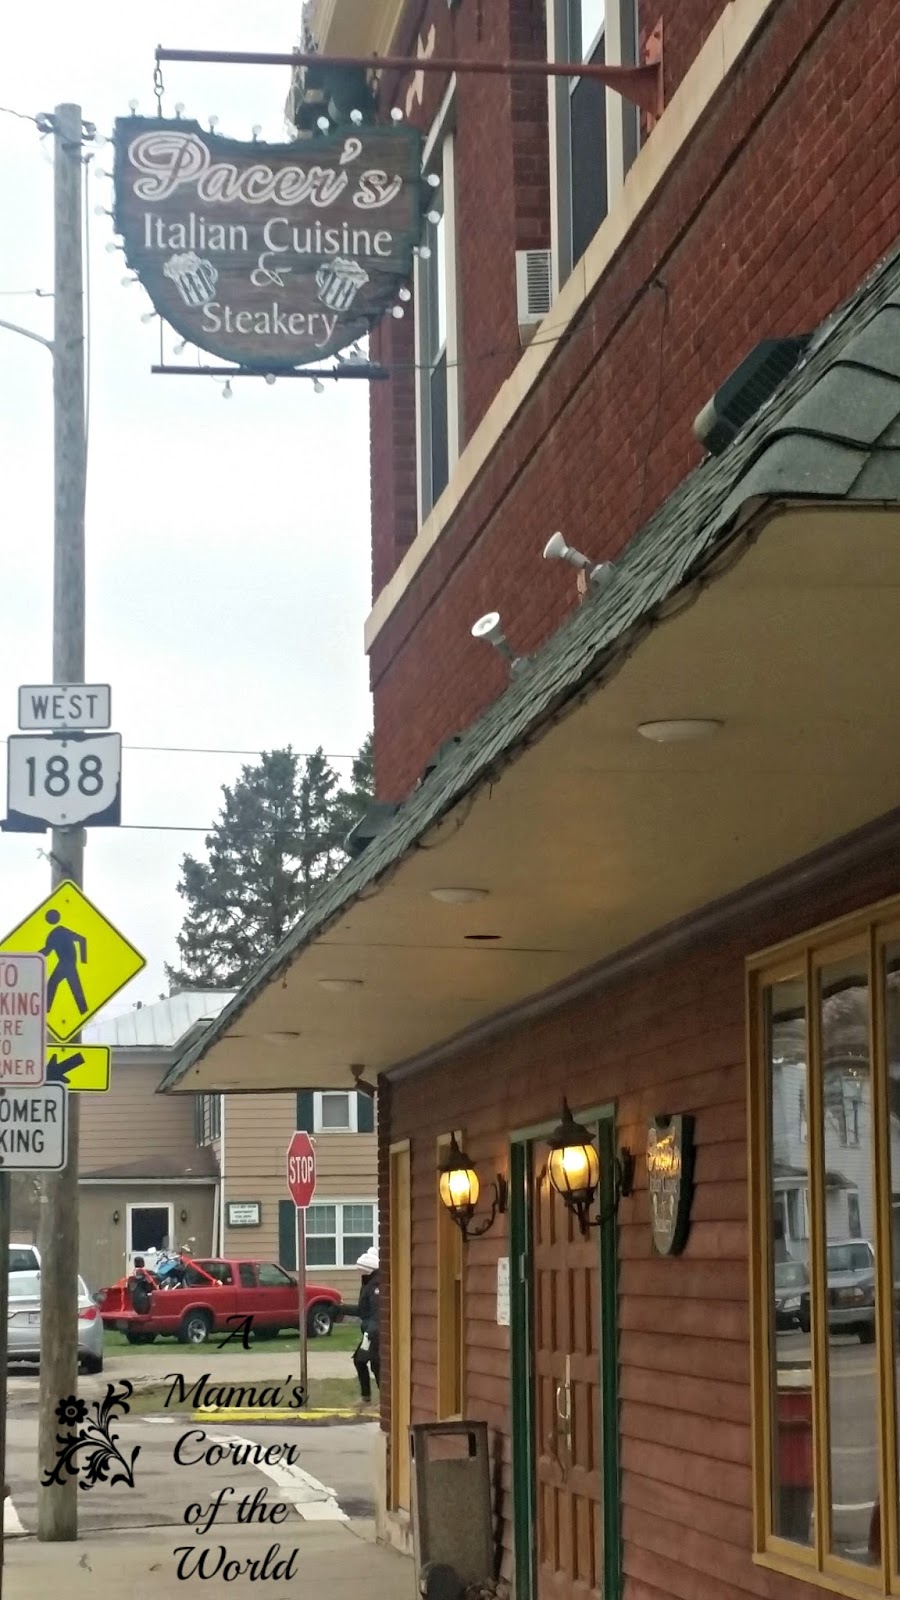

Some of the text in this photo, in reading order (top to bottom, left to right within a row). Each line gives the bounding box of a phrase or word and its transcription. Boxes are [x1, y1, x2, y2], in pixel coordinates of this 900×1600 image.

[128, 131, 402, 209] Pacer's
[144, 212, 393, 255] Italian Cuisine
[250, 252, 292, 287] &
[202, 302, 338, 347] Steakery
[31, 694, 98, 719] WEST
[26, 754, 103, 797] 188
[0, 1020, 24, 1036] RE
[289, 1156, 313, 1184] STOP
